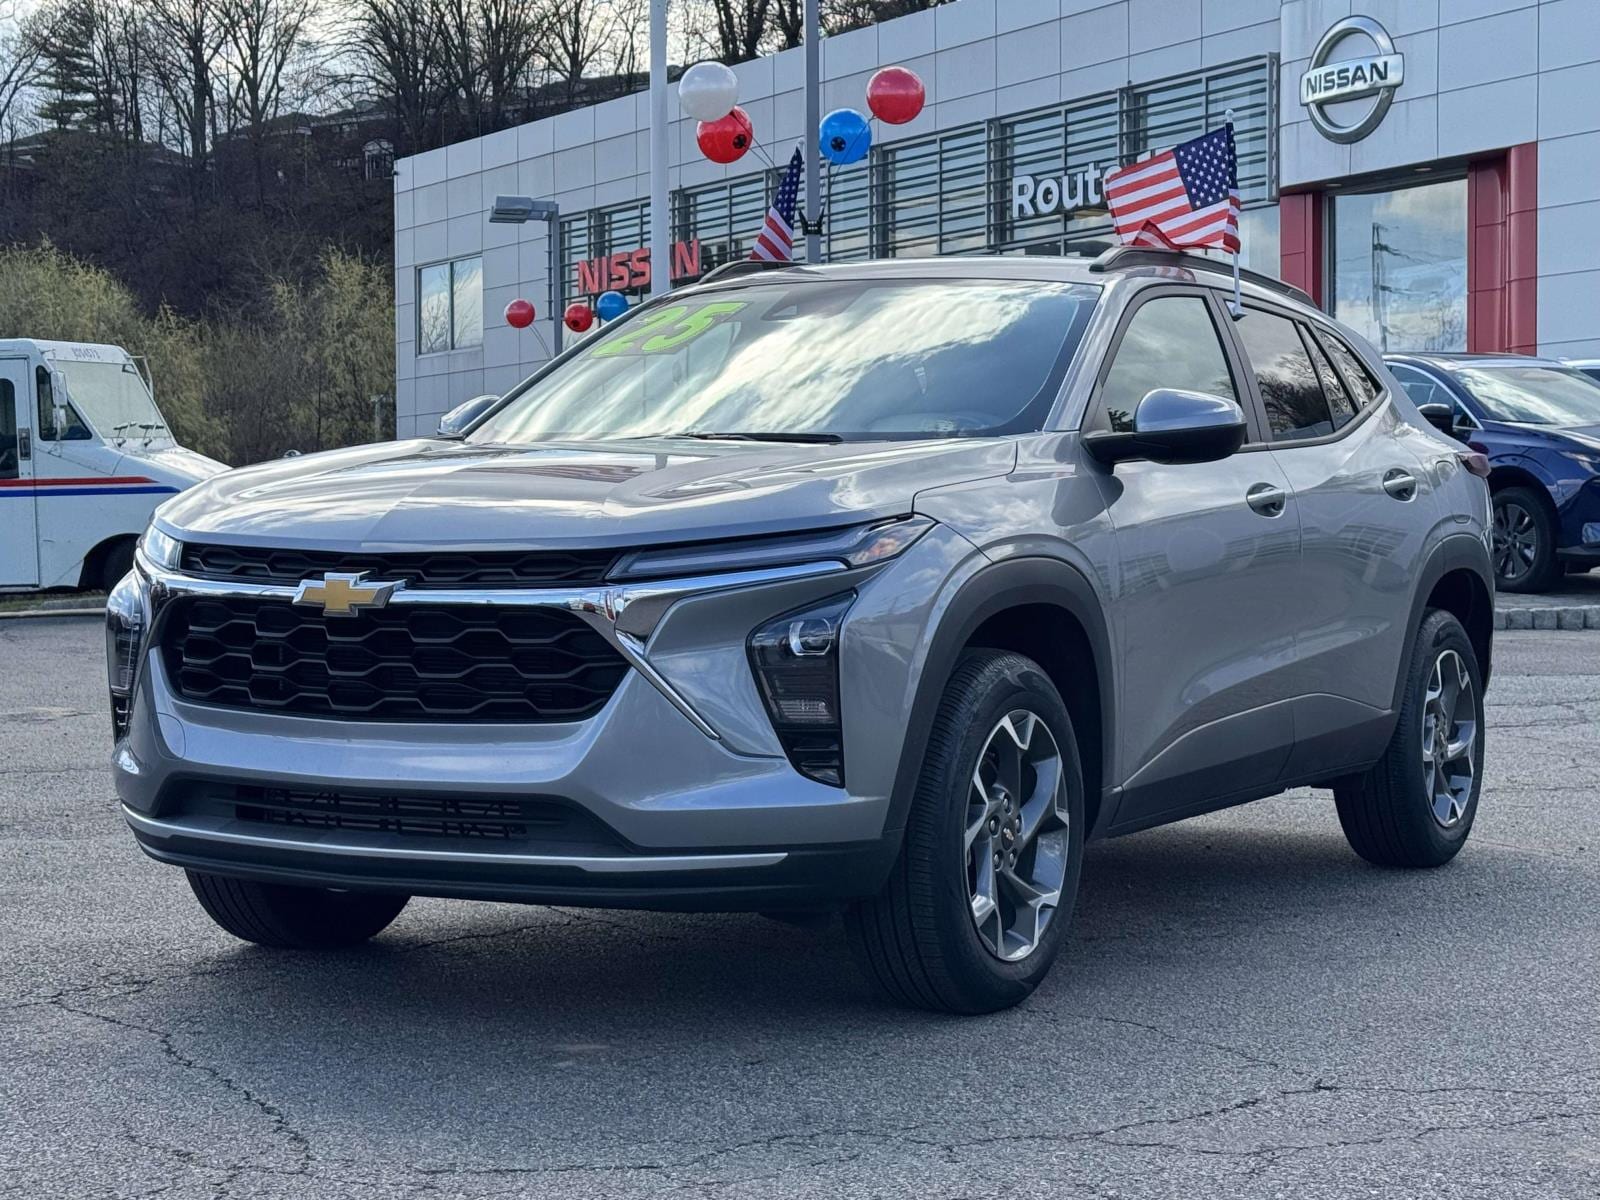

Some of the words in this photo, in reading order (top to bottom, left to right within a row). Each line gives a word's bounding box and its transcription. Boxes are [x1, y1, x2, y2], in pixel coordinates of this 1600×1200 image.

[1306, 61, 1388, 97] NISSAN
[578, 239, 698, 295] NISSN
[590, 301, 748, 357] 25
